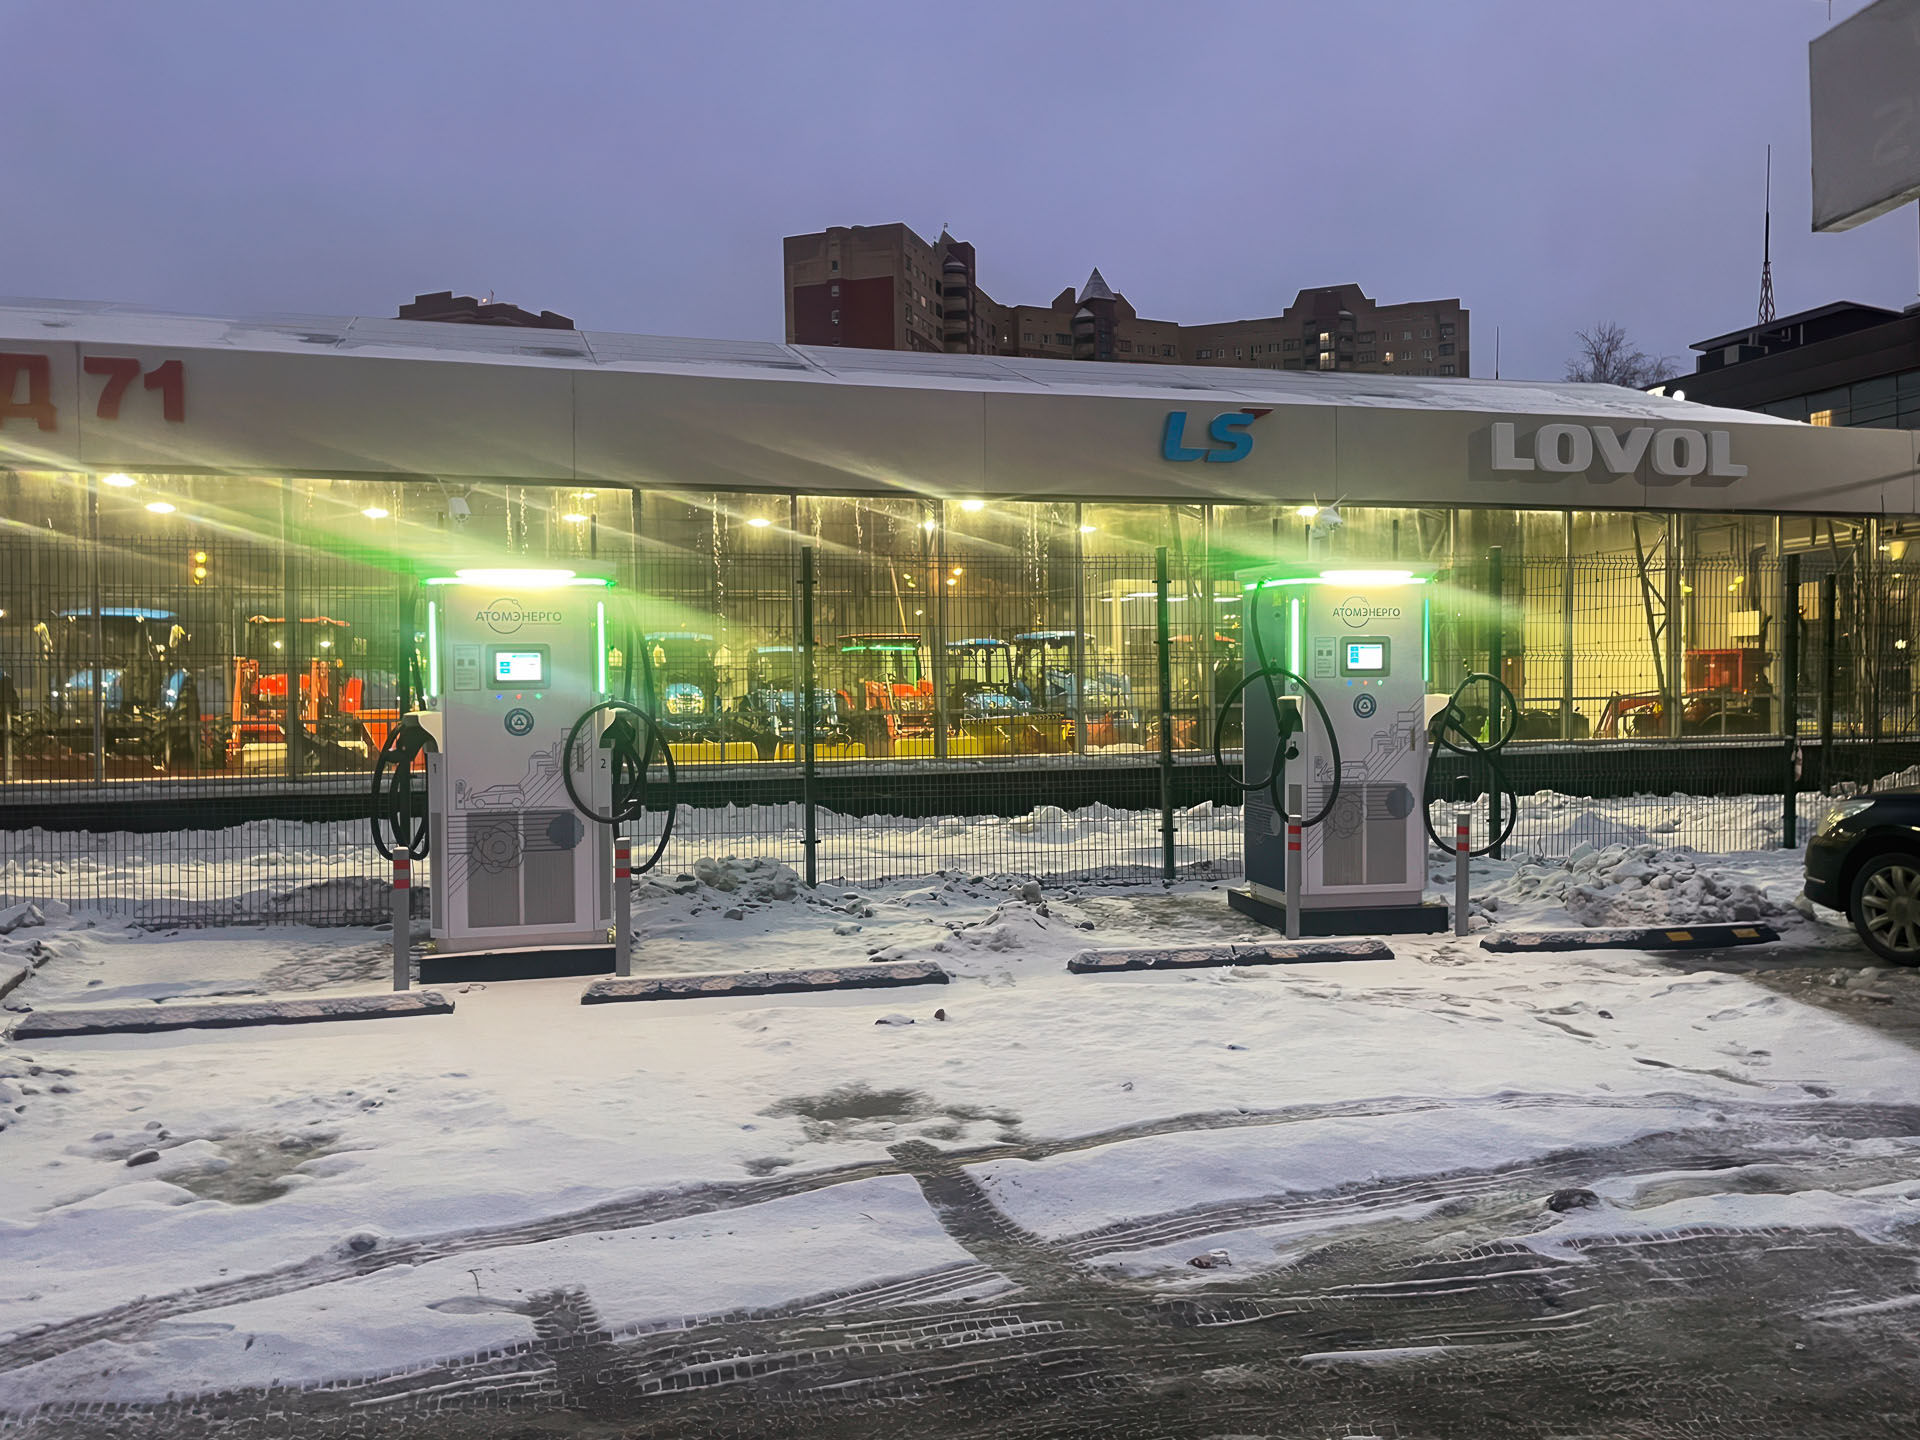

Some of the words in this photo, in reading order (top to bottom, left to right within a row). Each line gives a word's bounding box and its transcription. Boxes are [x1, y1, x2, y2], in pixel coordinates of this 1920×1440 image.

[83, 356, 185, 424] 71
[1164, 411, 1255, 463] LS
[1491, 422, 1748, 477] LOVOL
[475, 611, 562, 622] АТОМЭНЕРГО
[1333, 607, 1401, 617] АТОМЭНЕРГО
[600, 758, 607, 769] 2
